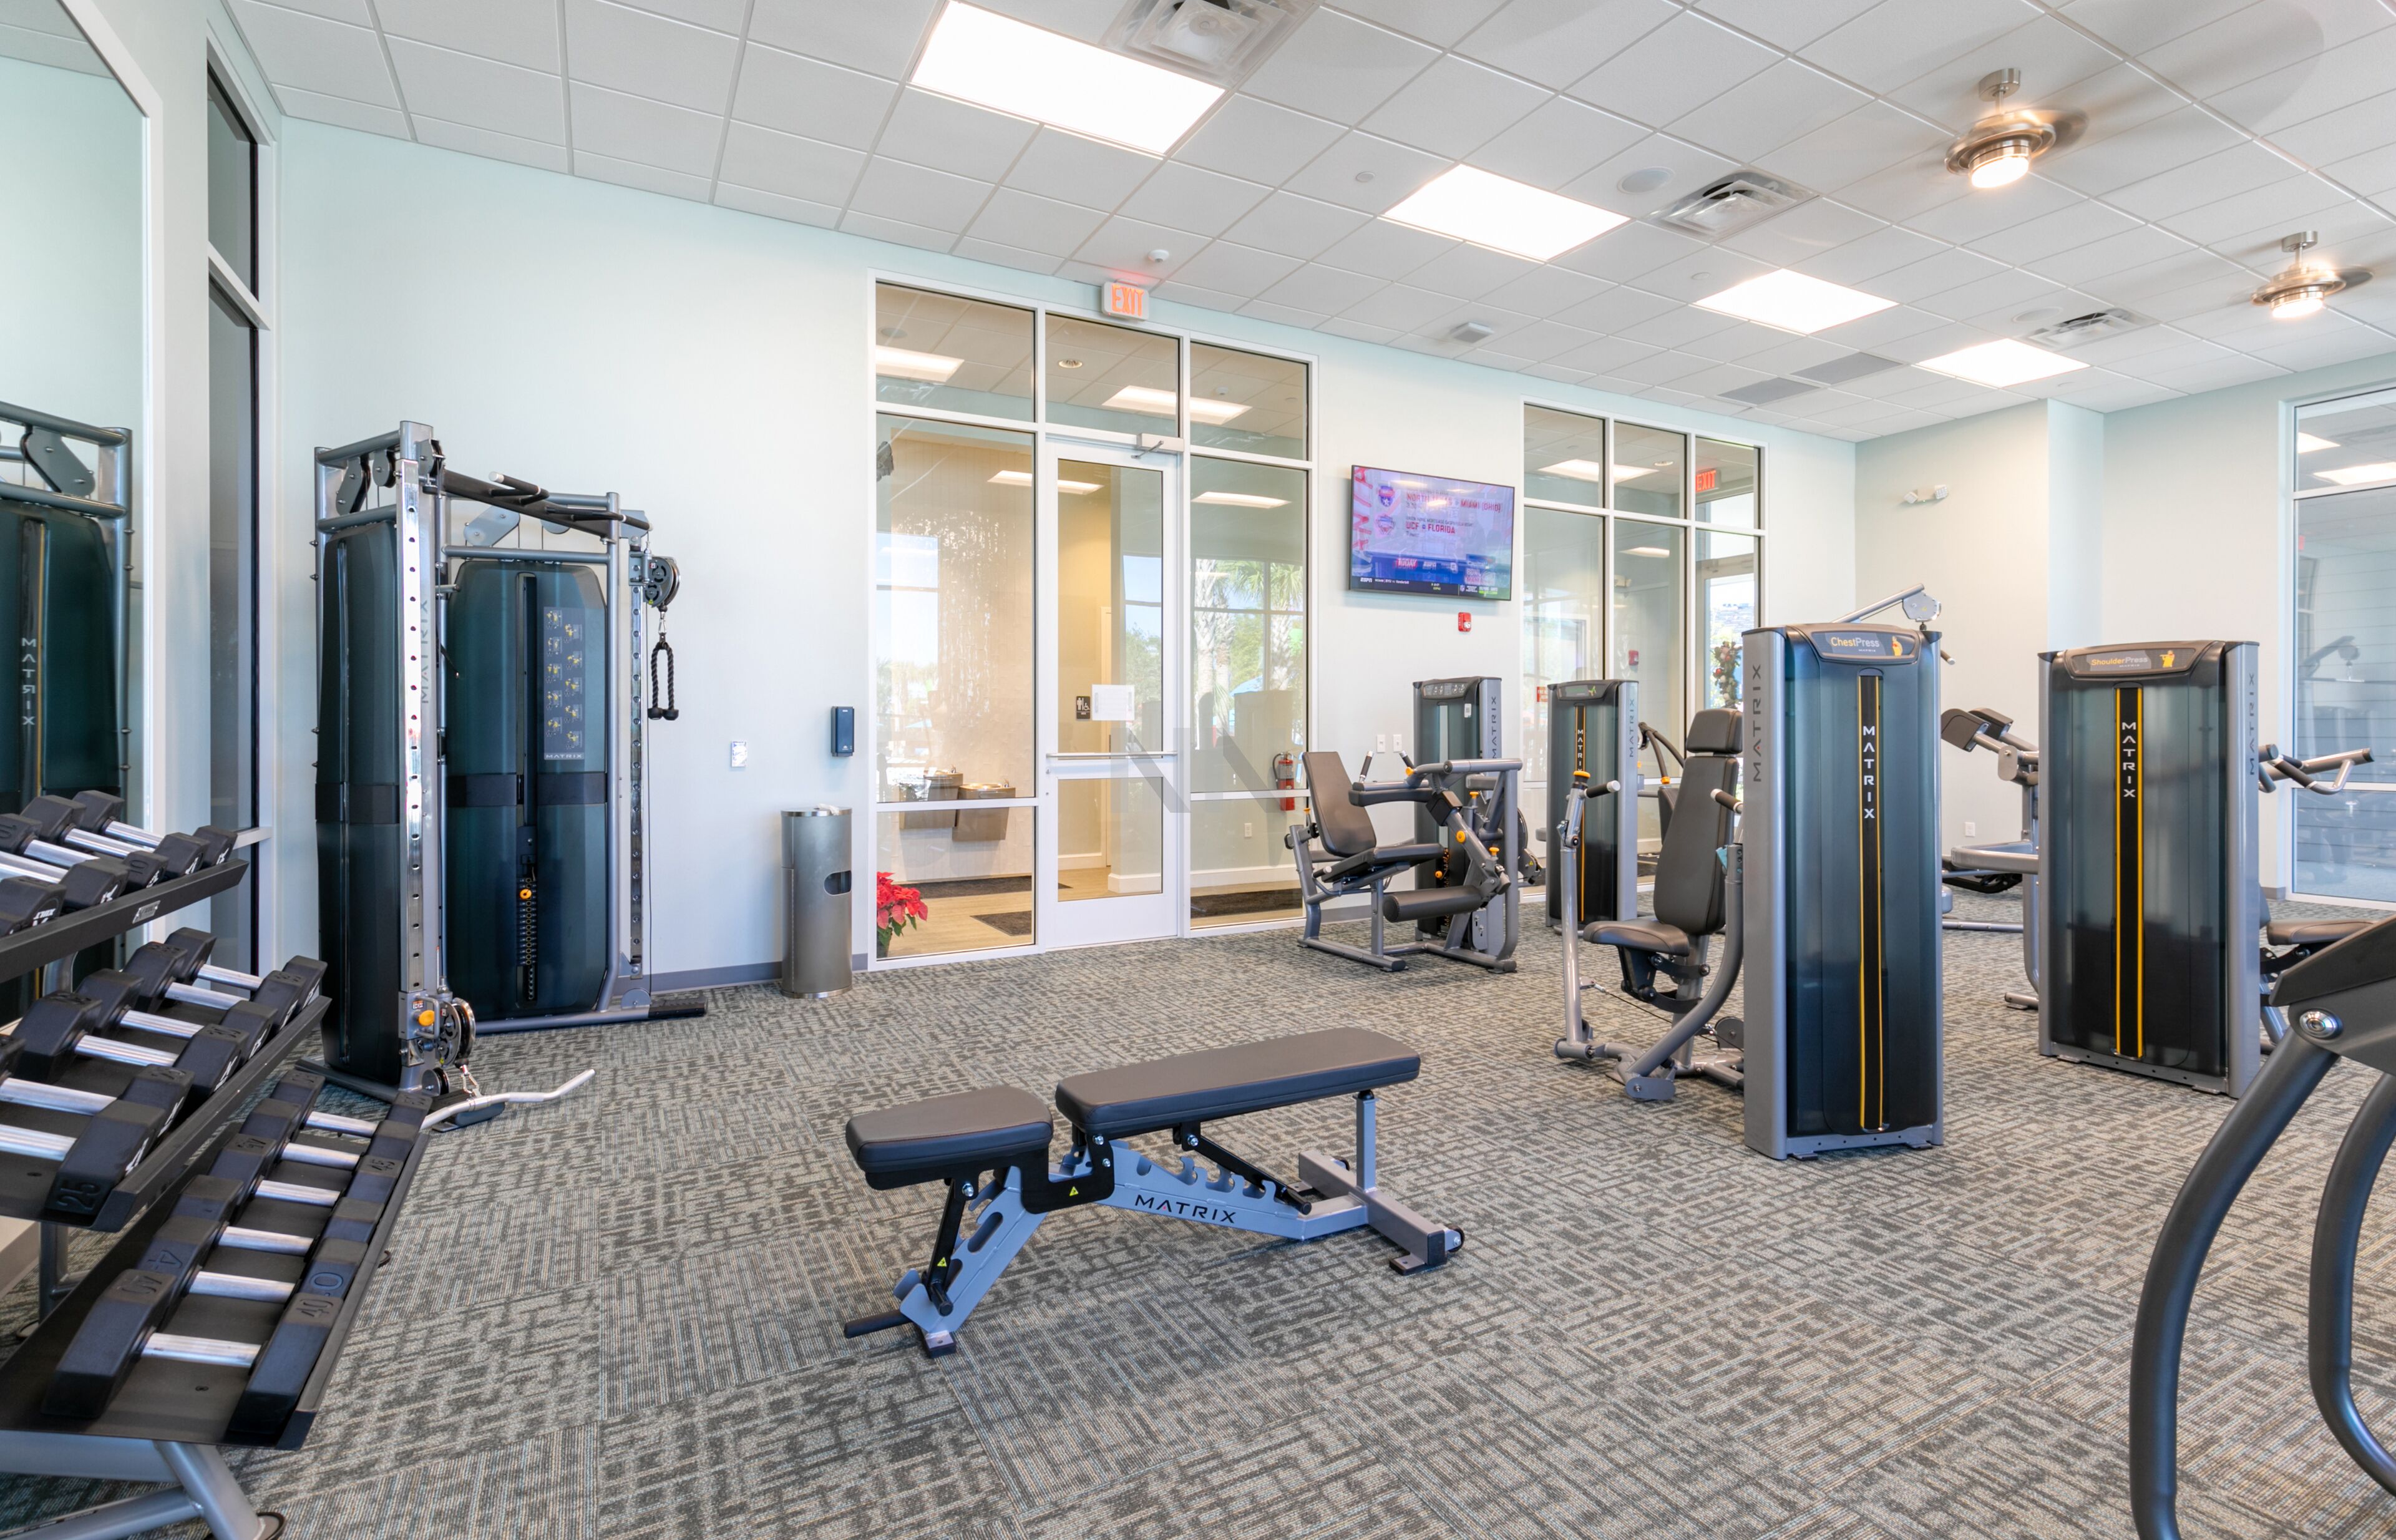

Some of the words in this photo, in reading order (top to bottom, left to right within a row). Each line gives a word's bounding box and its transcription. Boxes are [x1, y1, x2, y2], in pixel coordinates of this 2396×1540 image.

[1112, 284, 1144, 316] EXIT
[1696, 469, 1716, 492] EXIT
[1461, 499, 1479, 509] MIAMI
[1406, 522, 1419, 530] UCF
[1428, 524, 1456, 534] FLORIDA
[1398, 558, 1418, 568] TODAY
[1831, 637, 1880, 647] ChestPress
[2091, 656, 2148, 666] ShoulderPress
[1753, 665, 1761, 782] MATRIX
[2122, 722, 2136, 798] MATRIX
[1863, 726, 1875, 819] MATRIX
[1135, 1194, 1236, 1224] MATRIX
